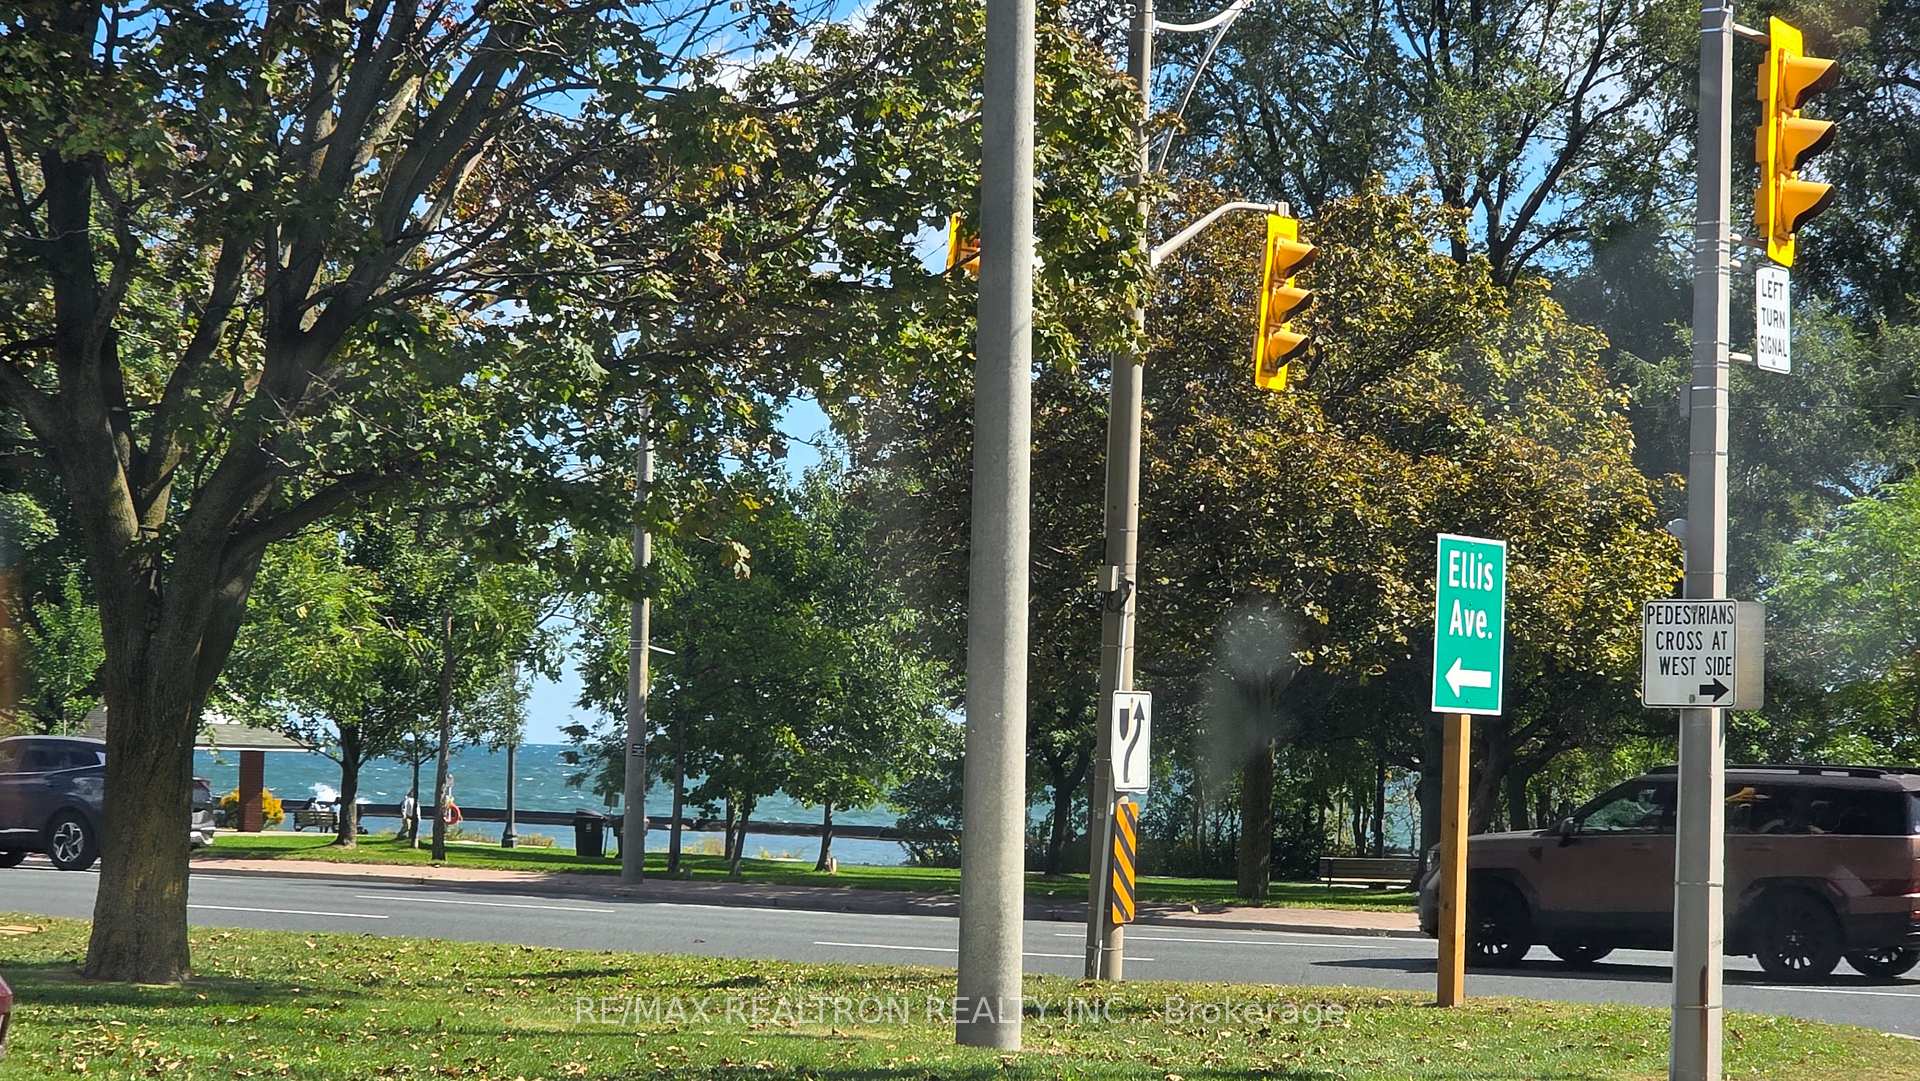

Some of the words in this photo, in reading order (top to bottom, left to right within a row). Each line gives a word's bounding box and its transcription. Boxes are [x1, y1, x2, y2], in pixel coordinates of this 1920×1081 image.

[1761, 279, 1784, 301] LEFT
[1761, 307, 1786, 330] TURN
[1760, 335, 1788, 359] SIGNAL
[1449, 550, 1494, 592] Ellis
[1449, 599, 1493, 640] Ave.
[1647, 605, 1734, 625] PEDESTRIANS
[1656, 631, 1703, 651] CROSS
[1711, 631, 1728, 651] AT
[1659, 656, 1696, 676] WEST
[1705, 656, 1733, 676] SIDE
